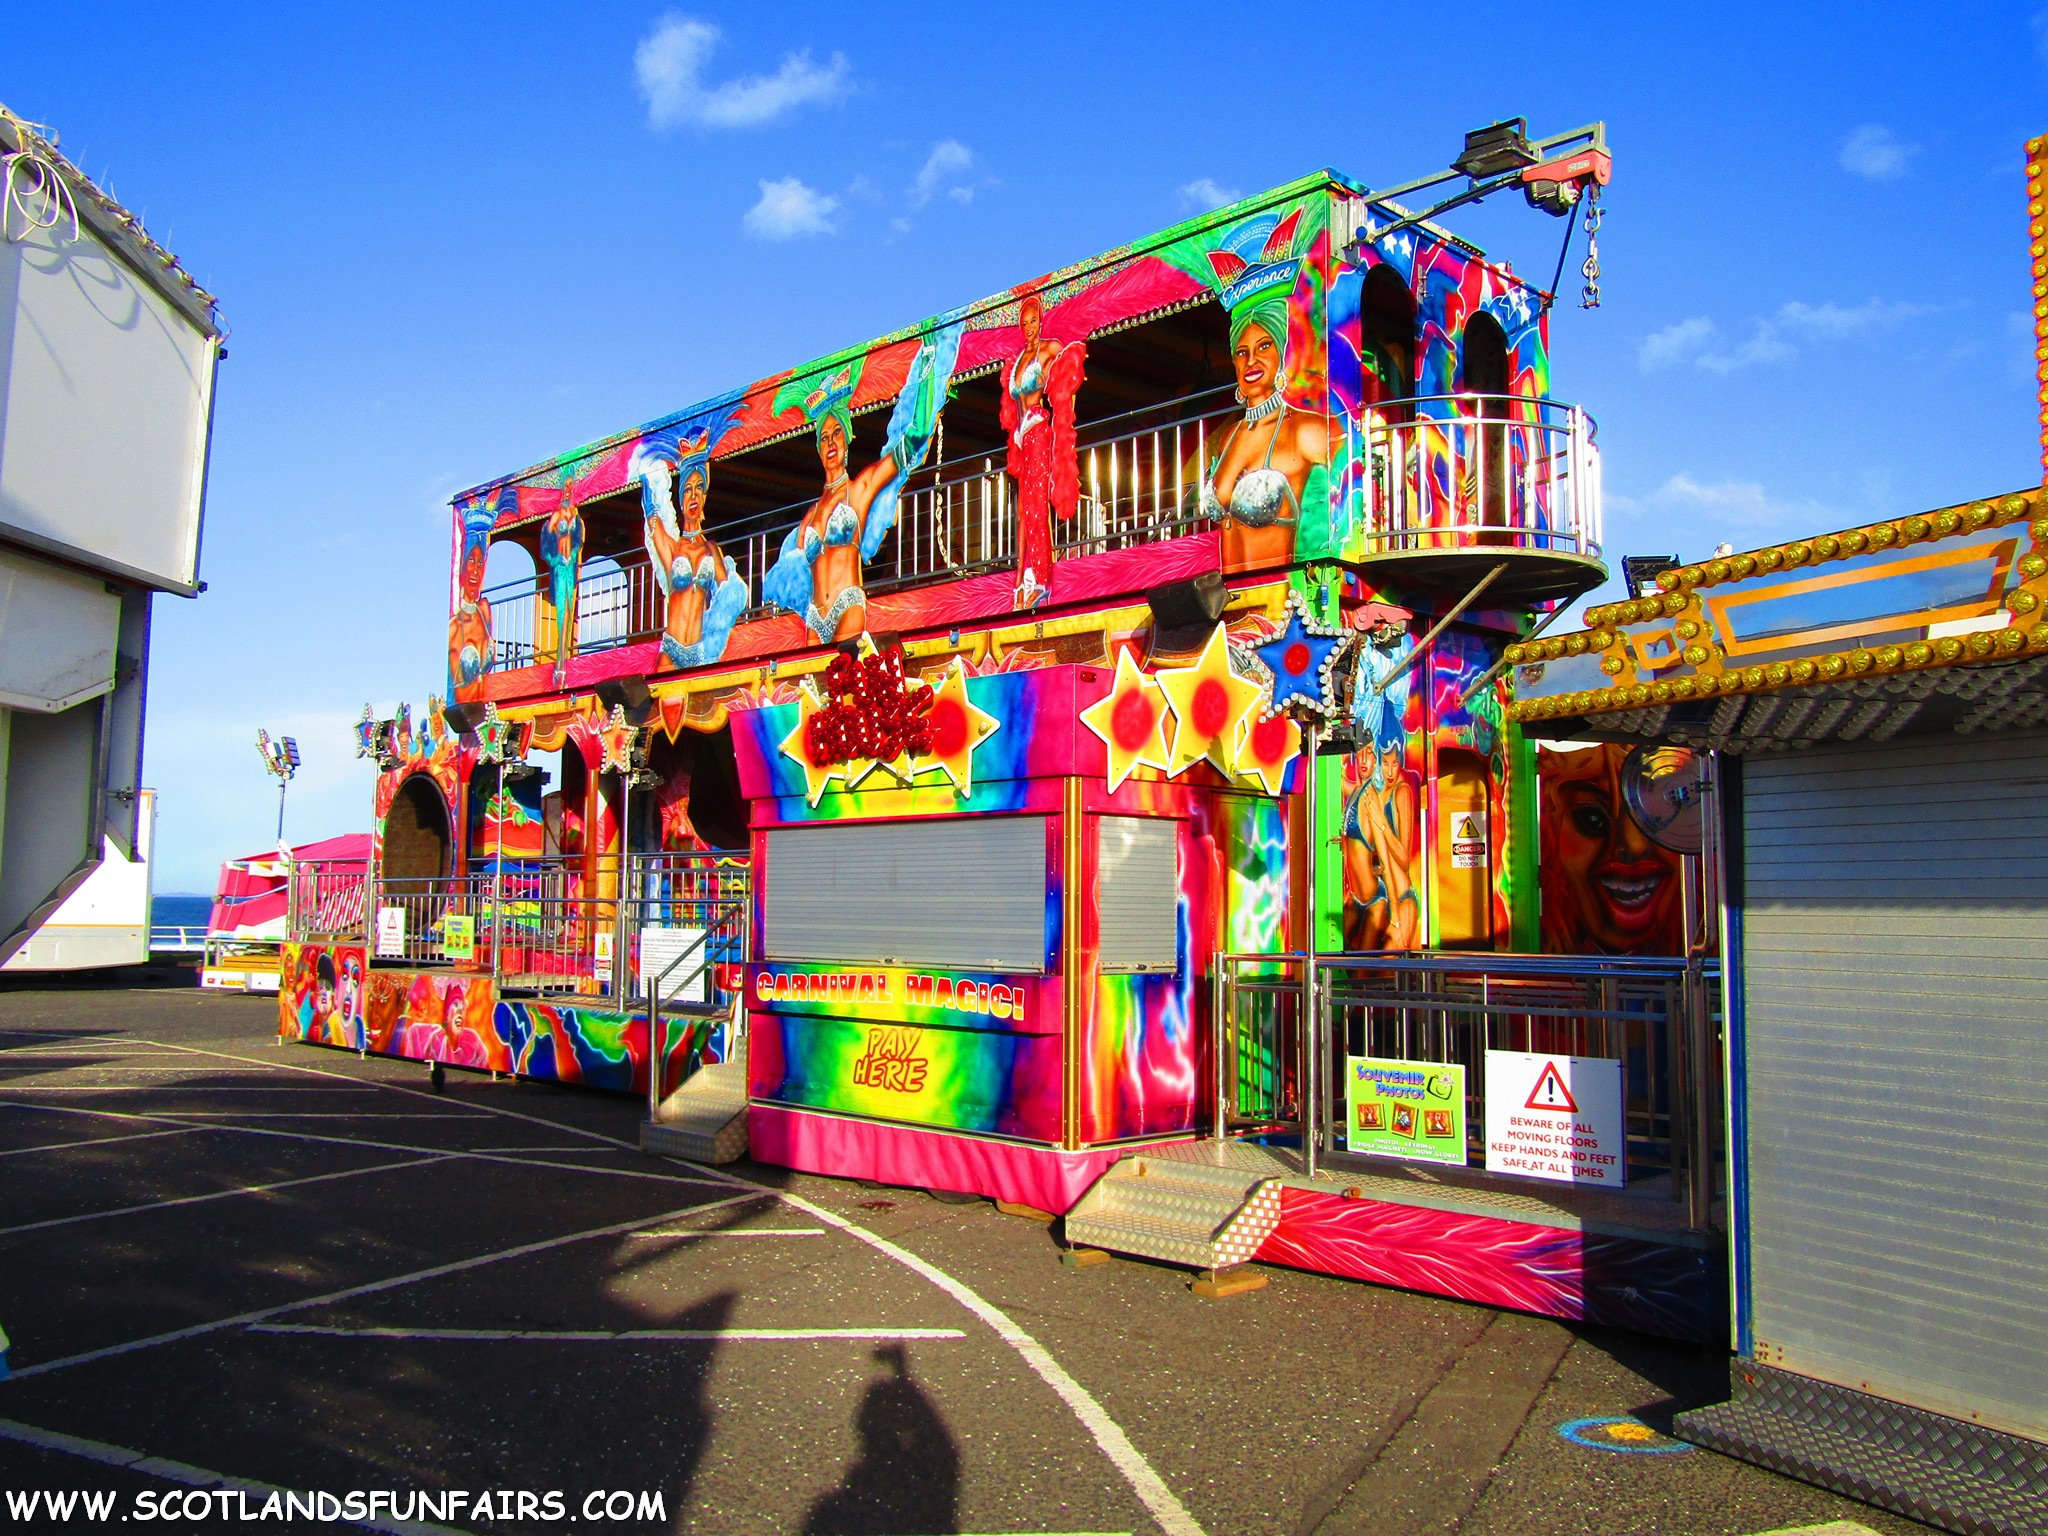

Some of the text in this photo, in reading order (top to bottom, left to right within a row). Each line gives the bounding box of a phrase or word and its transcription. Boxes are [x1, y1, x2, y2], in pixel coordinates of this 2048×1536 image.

[1221, 266, 1293, 308] Experience
[1454, 845, 1483, 853] DANGER
[756, 972, 1025, 1021] CARNIVAL MAGIC!
[867, 1026, 924, 1060] PAY
[853, 1057, 928, 1093] HERE
[1356, 1064, 1425, 1086] SOUVENIR
[1376, 1082, 1425, 1100] PHOTOS
[1510, 1116, 1594, 1134] BEWARE OF ALL
[1507, 1130, 1598, 1149] MOVING FLOORS
[1491, 1142, 1616, 1165] KEEP HANDS AND FEET
[1502, 1157, 1604, 1178] SAFE AT ALL TIMES
